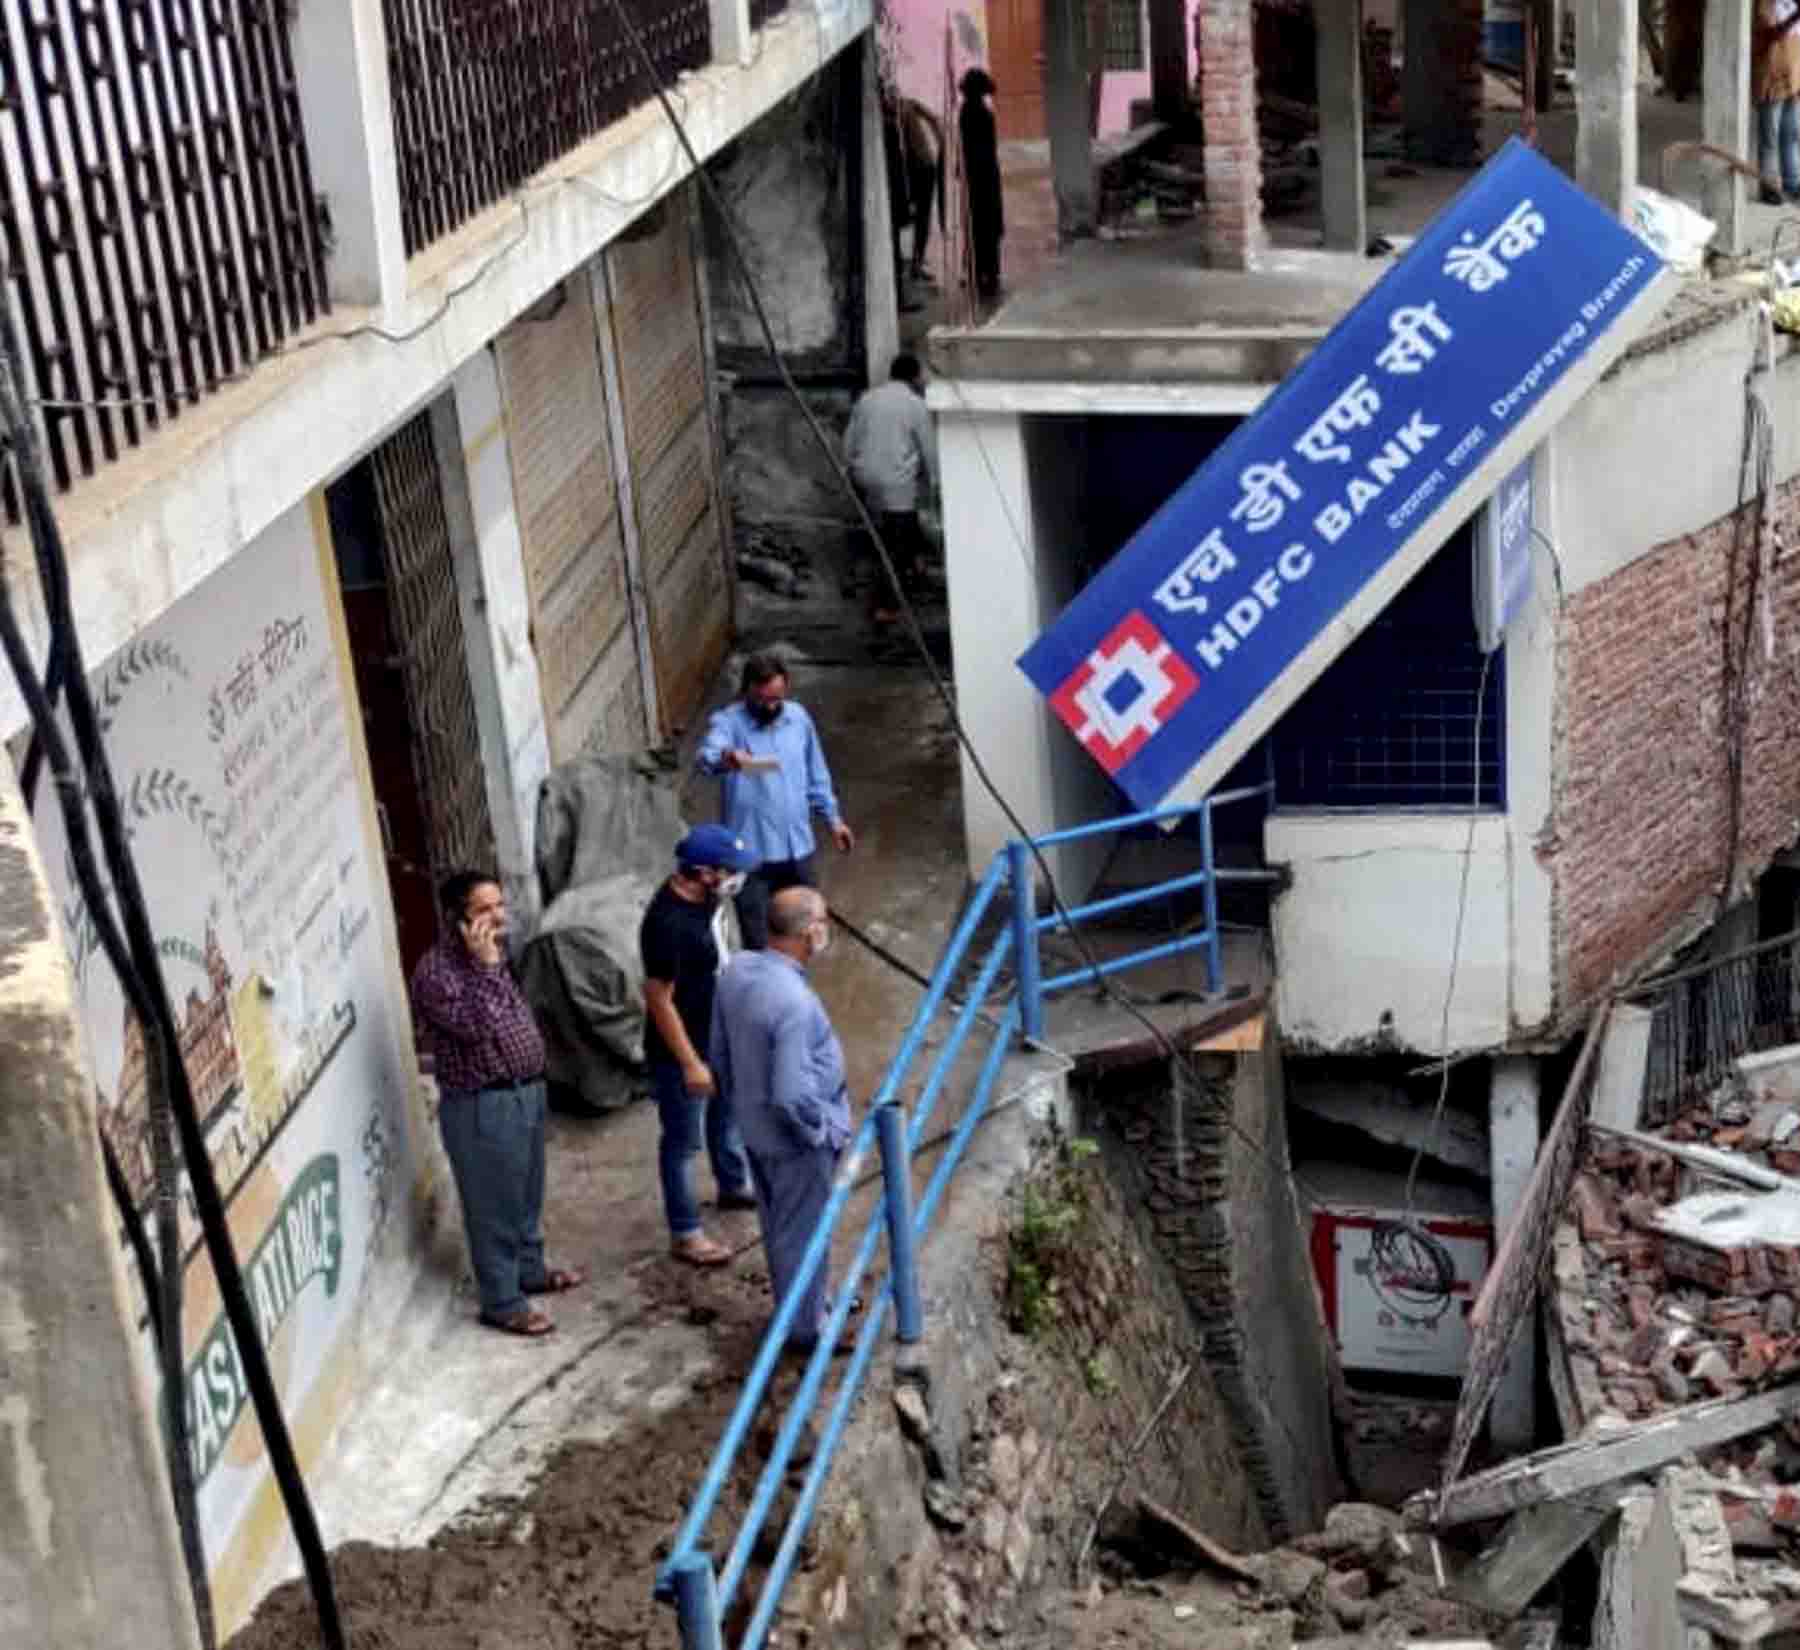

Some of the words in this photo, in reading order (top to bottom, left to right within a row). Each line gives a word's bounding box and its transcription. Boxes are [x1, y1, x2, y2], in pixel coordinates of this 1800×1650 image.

[1153, 527, 1237, 613] एच
[1229, 459, 1302, 532] डी
[1294, 374, 1382, 463] एफ
[1375, 300, 1453, 374] सी
[1442, 199, 1546, 292] बैंक
[1489, 319, 1588, 420] Devprayag
[1580, 254, 1647, 321] Branch
[1196, 543, 1314, 668] HDFC
[1314, 411, 1441, 543] BANK
[284, 1180, 337, 1284] RICE
